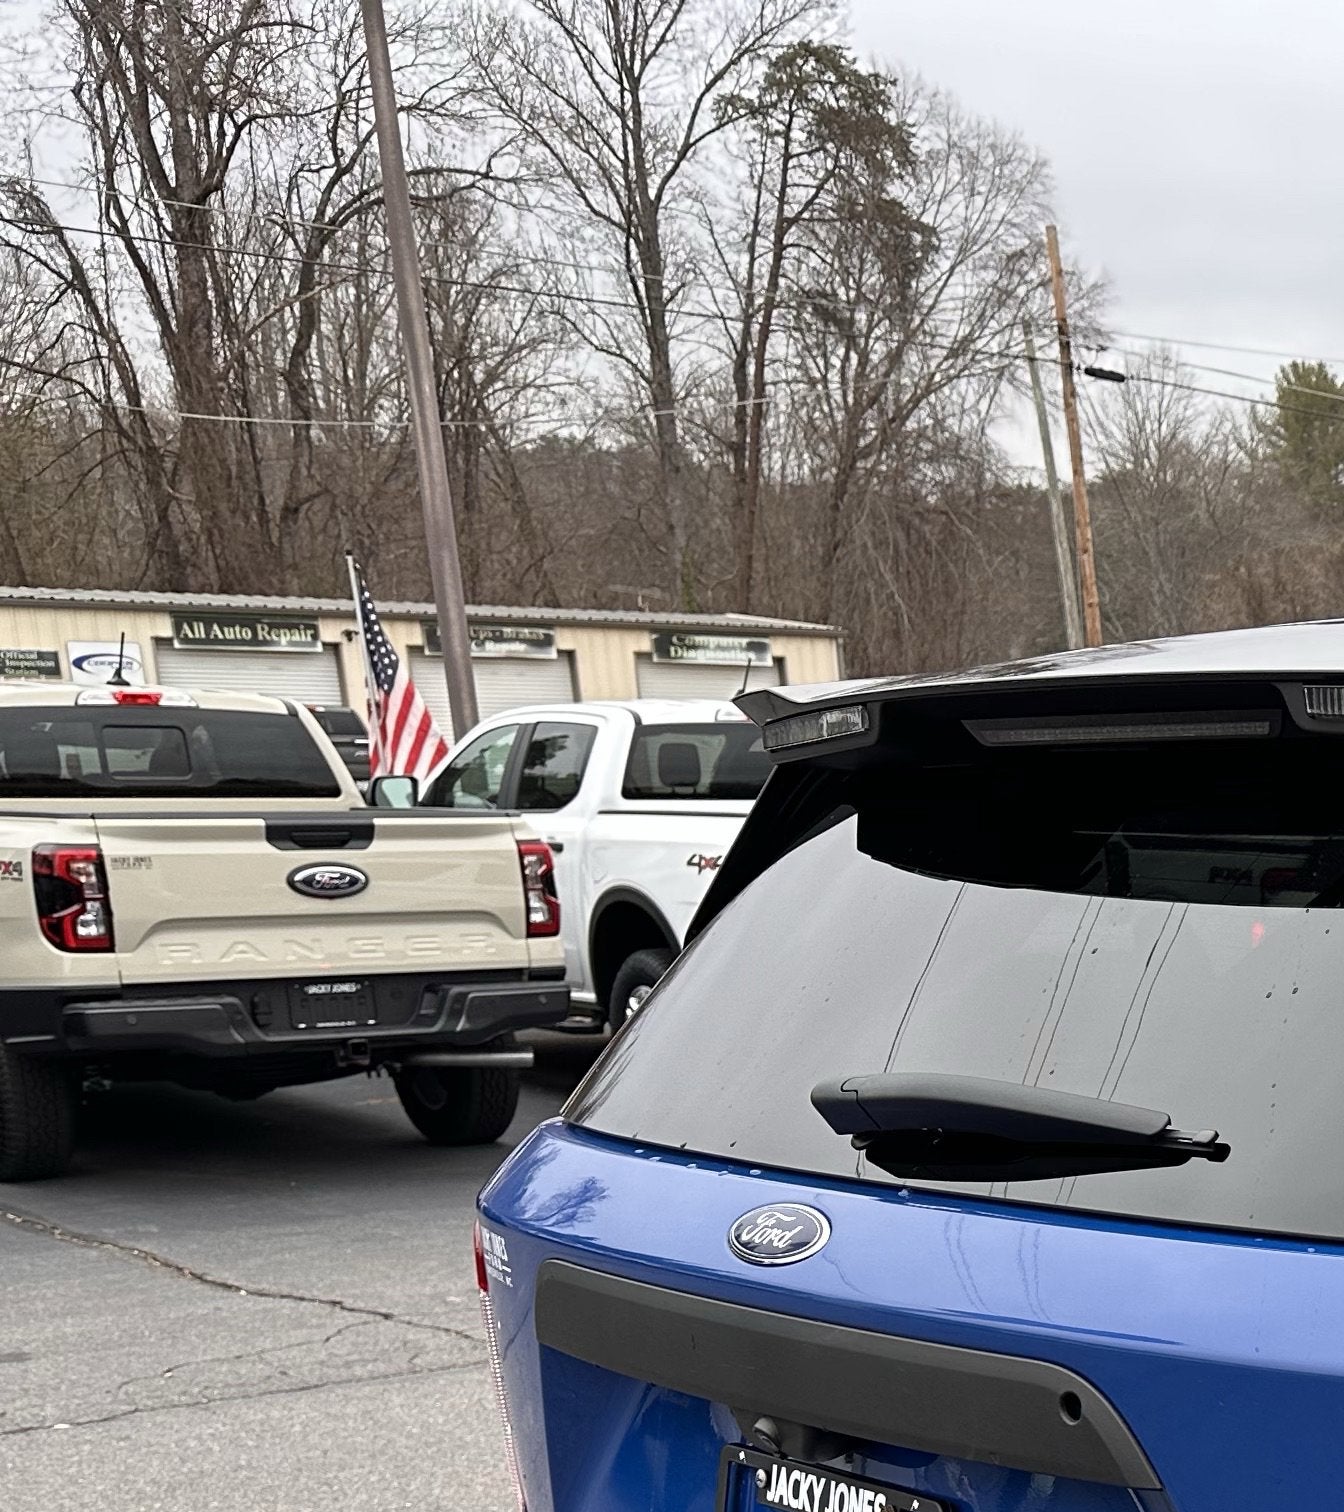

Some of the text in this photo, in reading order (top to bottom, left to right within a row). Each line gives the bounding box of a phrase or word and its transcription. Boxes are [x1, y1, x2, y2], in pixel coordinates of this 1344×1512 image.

[180, 621, 315, 646] All Auto Repair
[158, 932, 497, 965] RANGER
[741, 1210, 804, 1249] Ford
